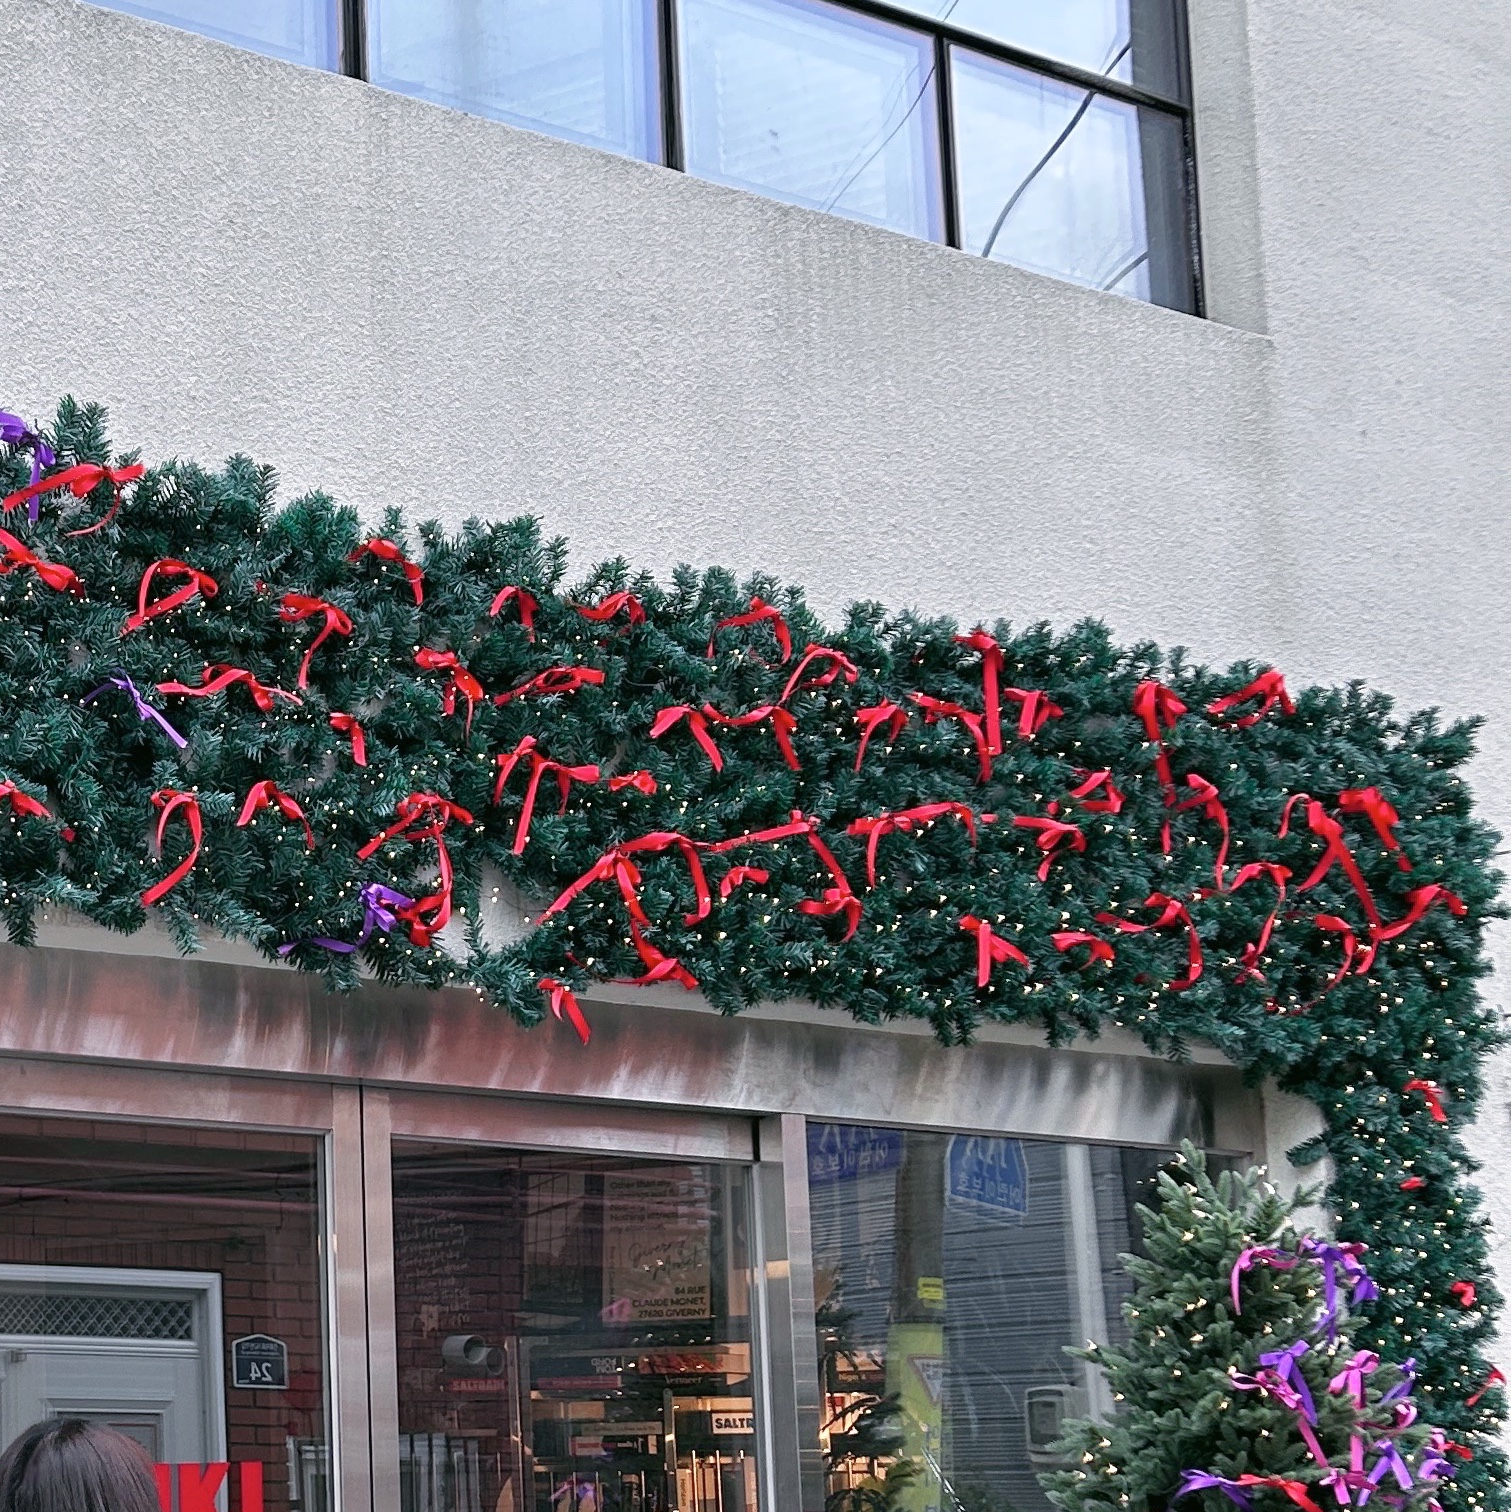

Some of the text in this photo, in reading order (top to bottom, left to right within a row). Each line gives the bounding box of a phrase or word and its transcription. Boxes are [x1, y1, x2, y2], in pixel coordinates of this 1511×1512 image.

[688, 1285, 706, 1294] RUE
[632, 1297, 669, 1308] CLAUDE
[665, 1308, 707, 1317] GIVERNY
